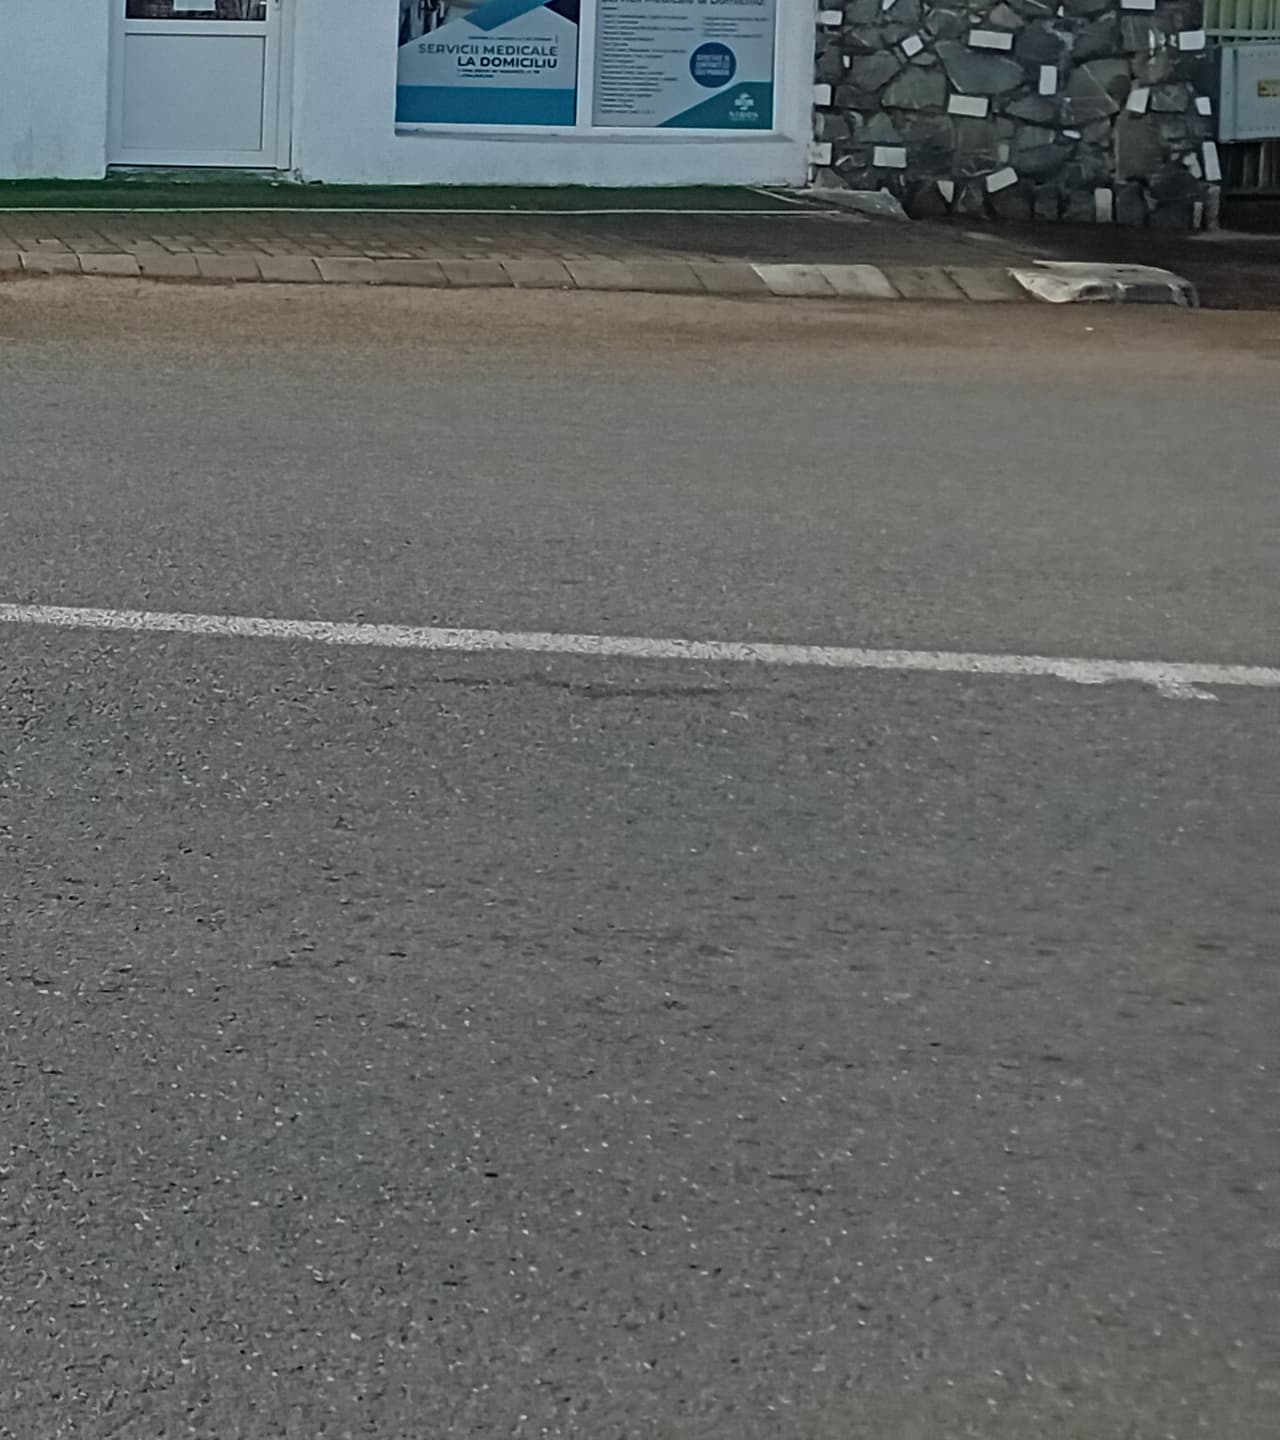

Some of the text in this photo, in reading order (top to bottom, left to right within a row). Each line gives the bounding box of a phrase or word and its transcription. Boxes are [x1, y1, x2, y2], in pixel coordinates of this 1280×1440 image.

[418, 43, 558, 57] SERVICII MEDICALE
[457, 56, 557, 69] LA DOMICILIU
